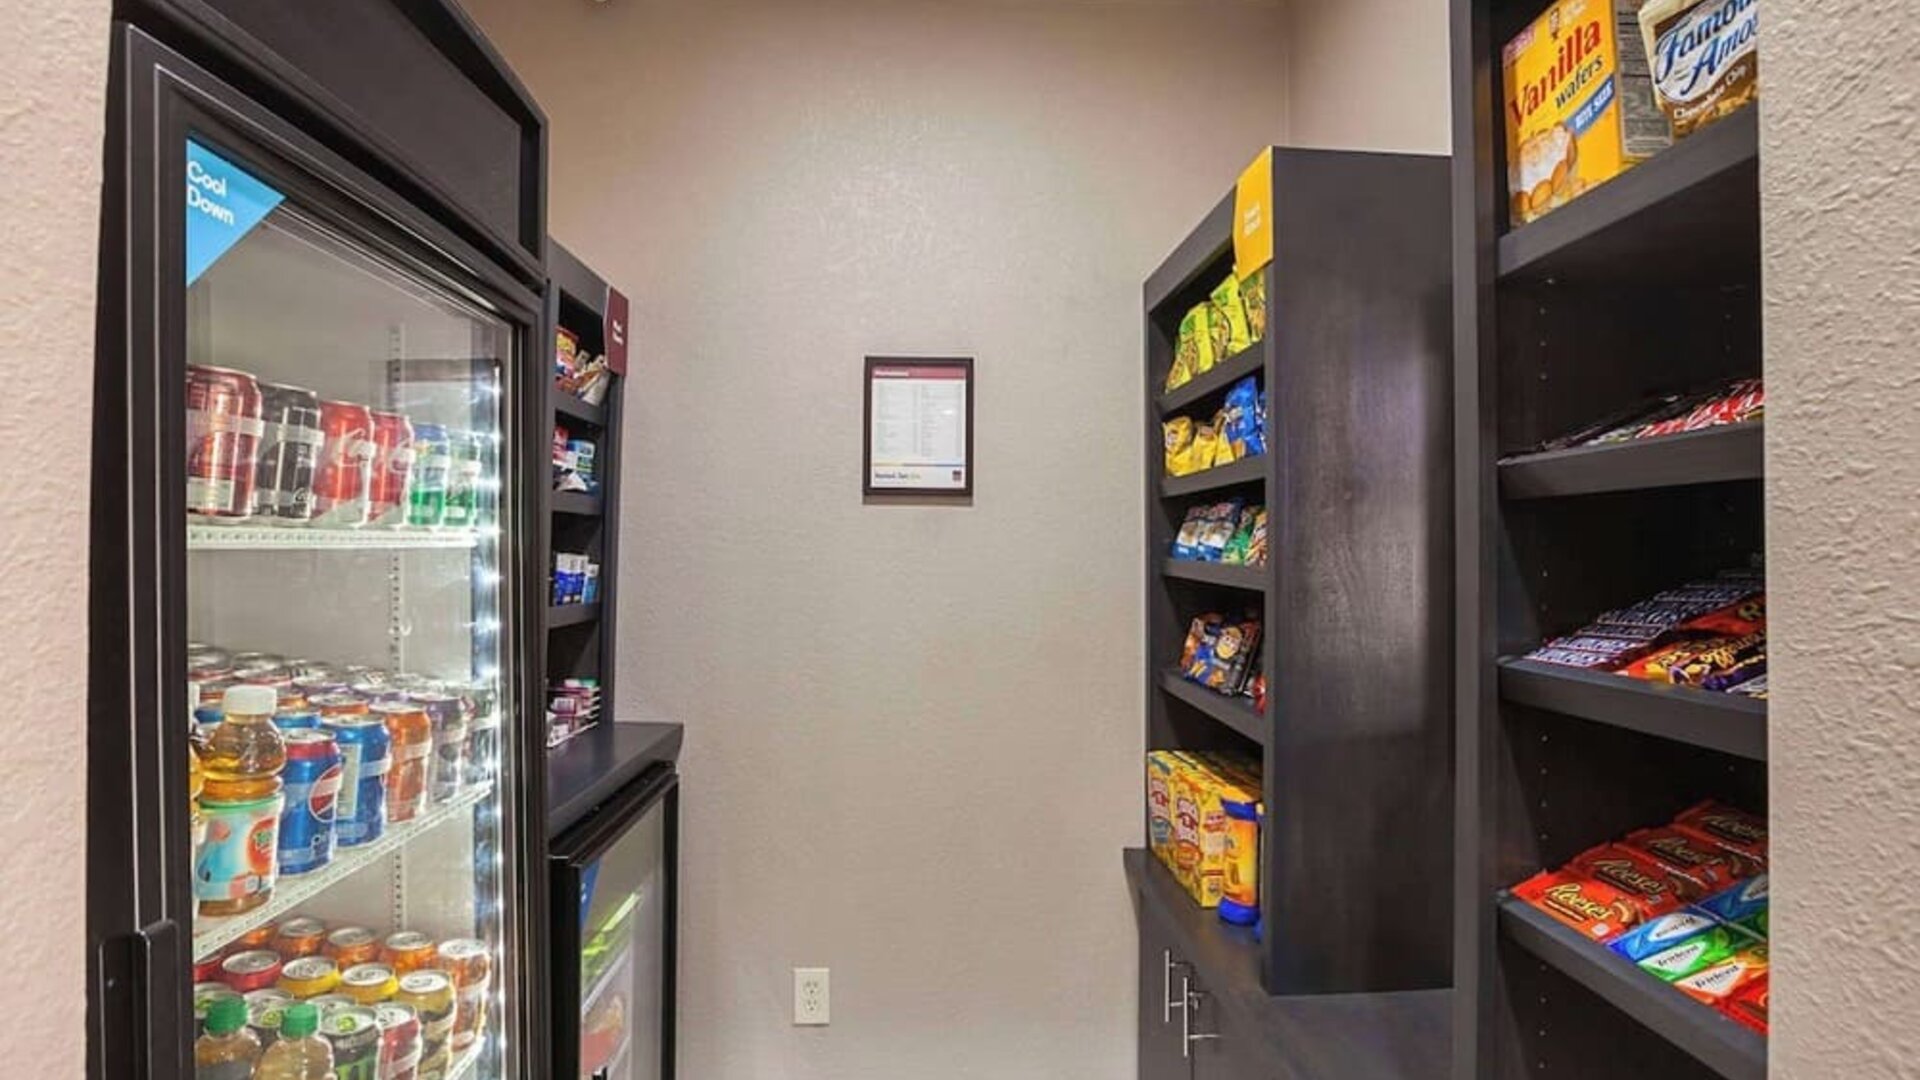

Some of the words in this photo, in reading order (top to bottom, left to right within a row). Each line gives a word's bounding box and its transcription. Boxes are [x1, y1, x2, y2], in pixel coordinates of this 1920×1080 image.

[1510, 20, 1601, 126] Vanilla
[1555, 54, 1603, 109] wafers
[187, 160, 226, 197] Cool
[187, 185, 235, 225] Down
